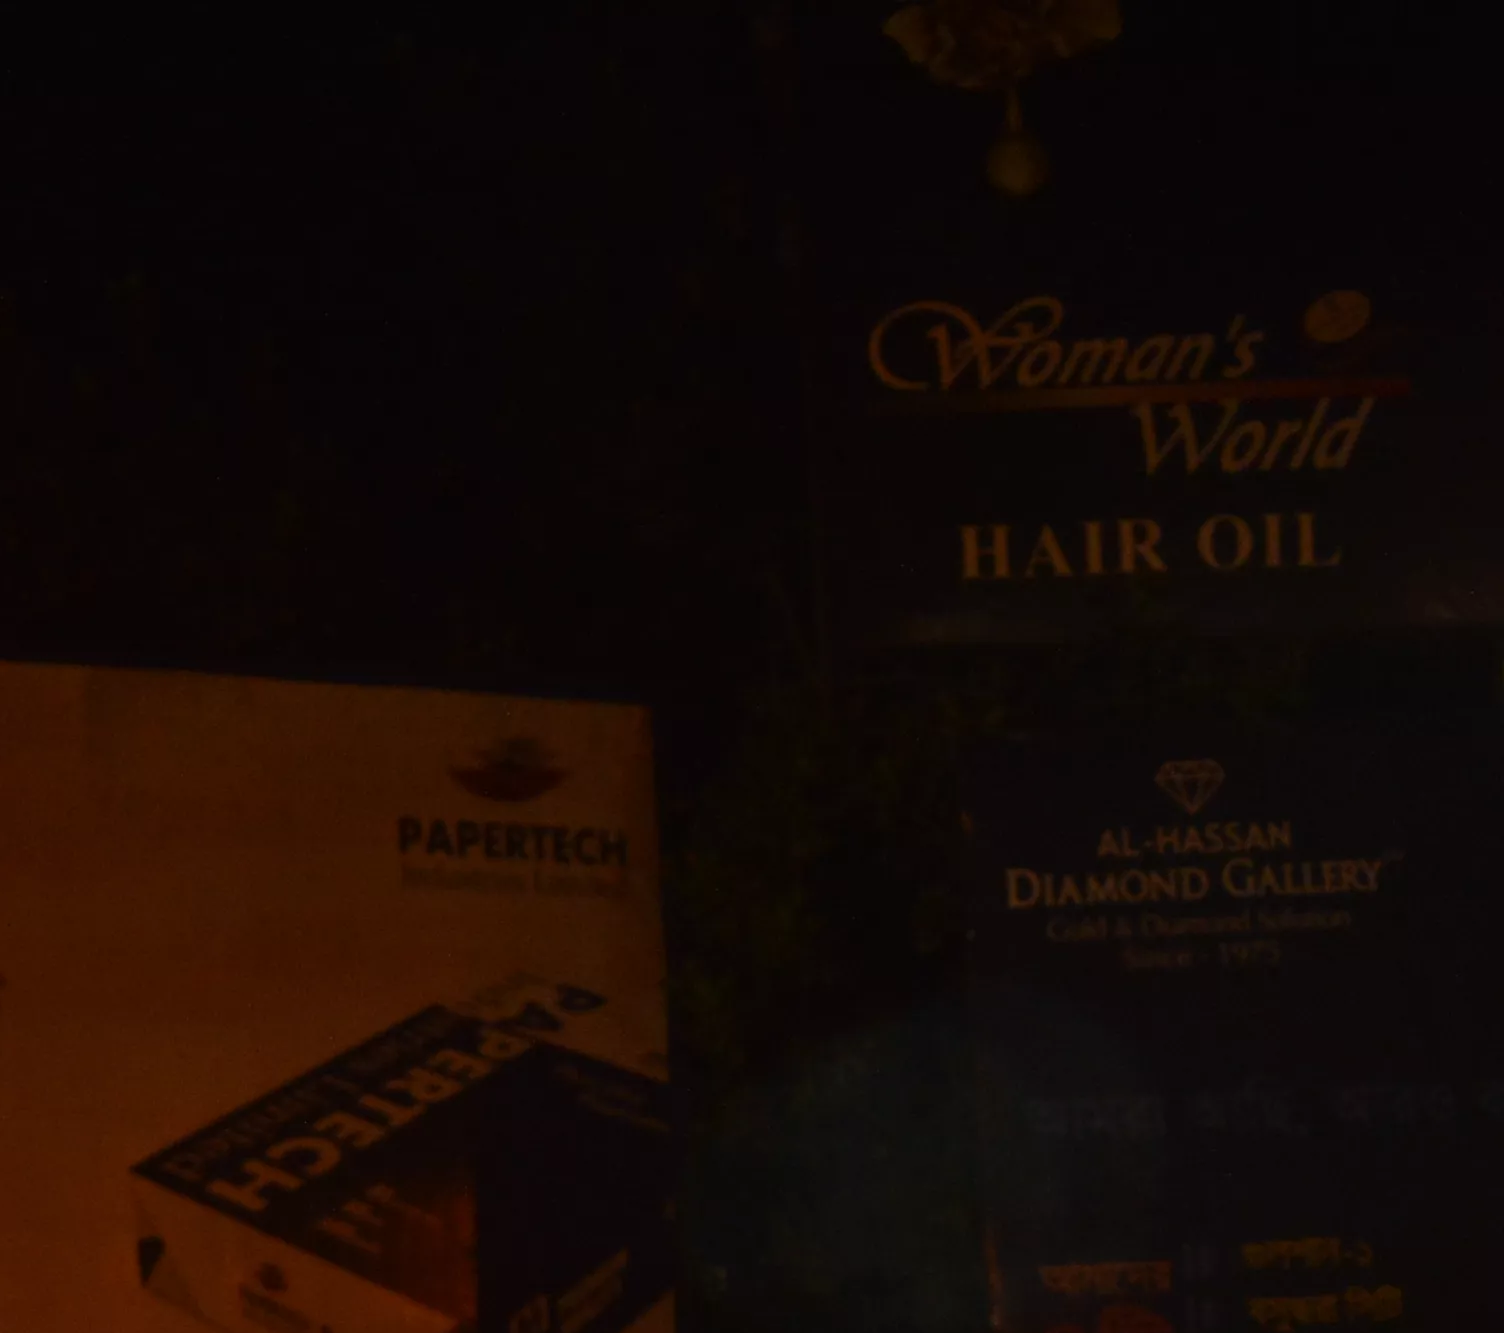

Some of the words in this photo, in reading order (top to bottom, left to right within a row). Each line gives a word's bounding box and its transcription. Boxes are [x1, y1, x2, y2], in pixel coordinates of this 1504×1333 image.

[867, 295, 1266, 391] Woman's
[1130, 397, 1375, 475] World
[958, 516, 1168, 581] HAIR
[1196, 512, 1340, 573] OIL
[397, 815, 630, 870] PAPERTECH
[1096, 820, 1292, 857] AL-HASSAN
[1005, 867, 1210, 909] DIAMOND
[1220, 856, 1383, 898] GALLERY
